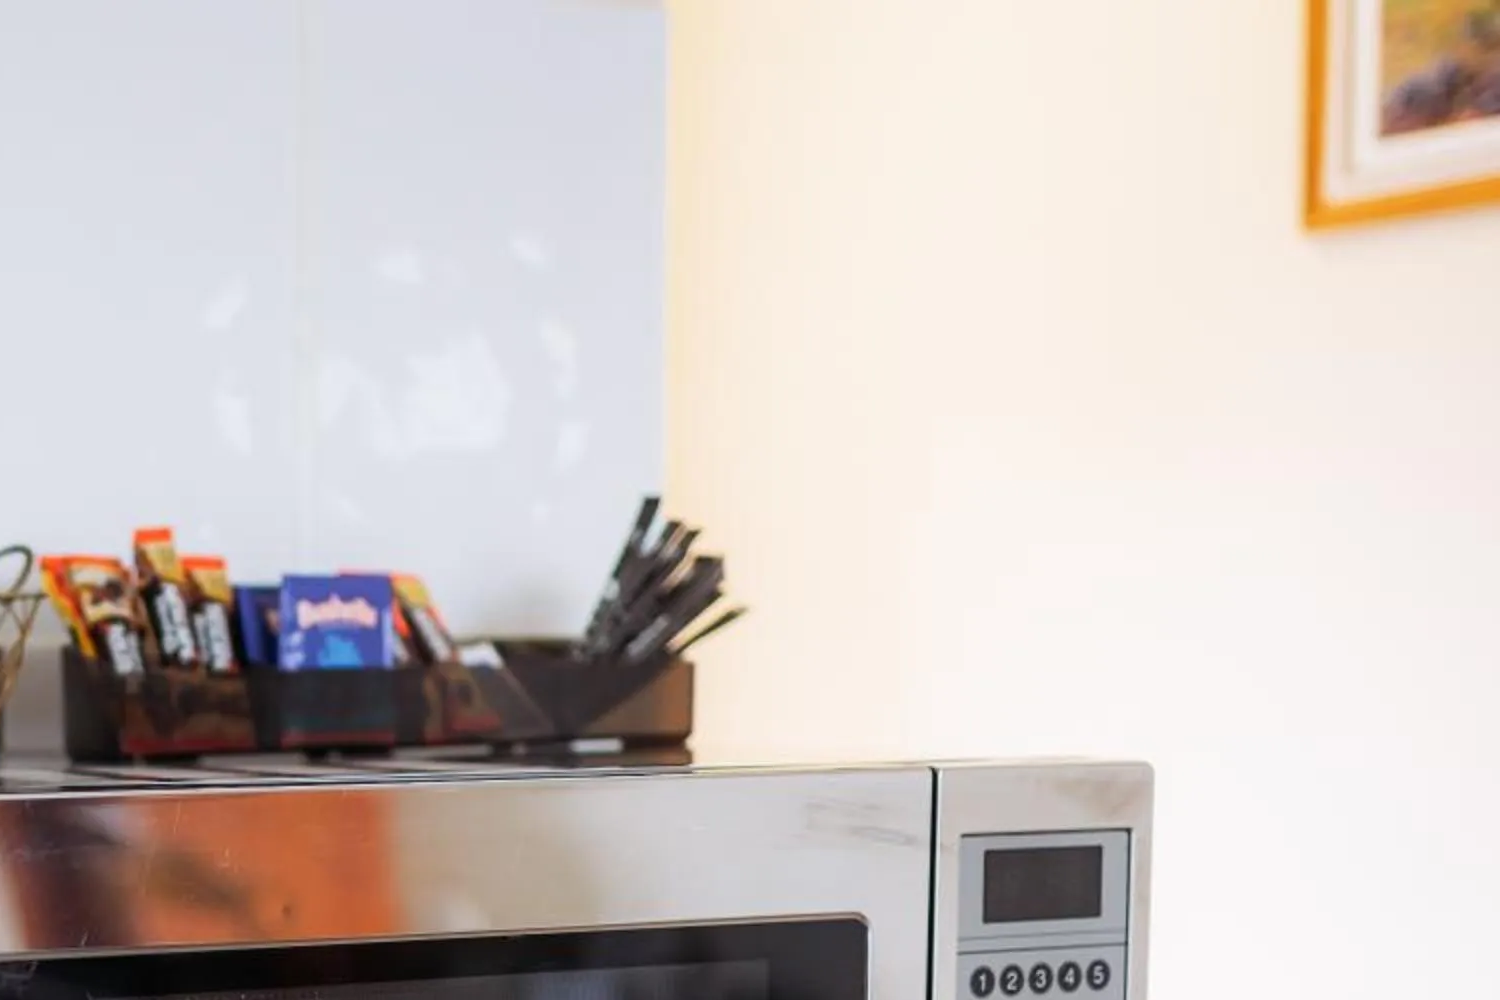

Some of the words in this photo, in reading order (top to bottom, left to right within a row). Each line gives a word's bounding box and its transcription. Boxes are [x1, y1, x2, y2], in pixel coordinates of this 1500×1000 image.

[1007, 971, 1018, 991] 2
[1035, 969, 1047, 988] 3
[1064, 967, 1075, 986] 4
[1092, 965, 1105, 984] 5
